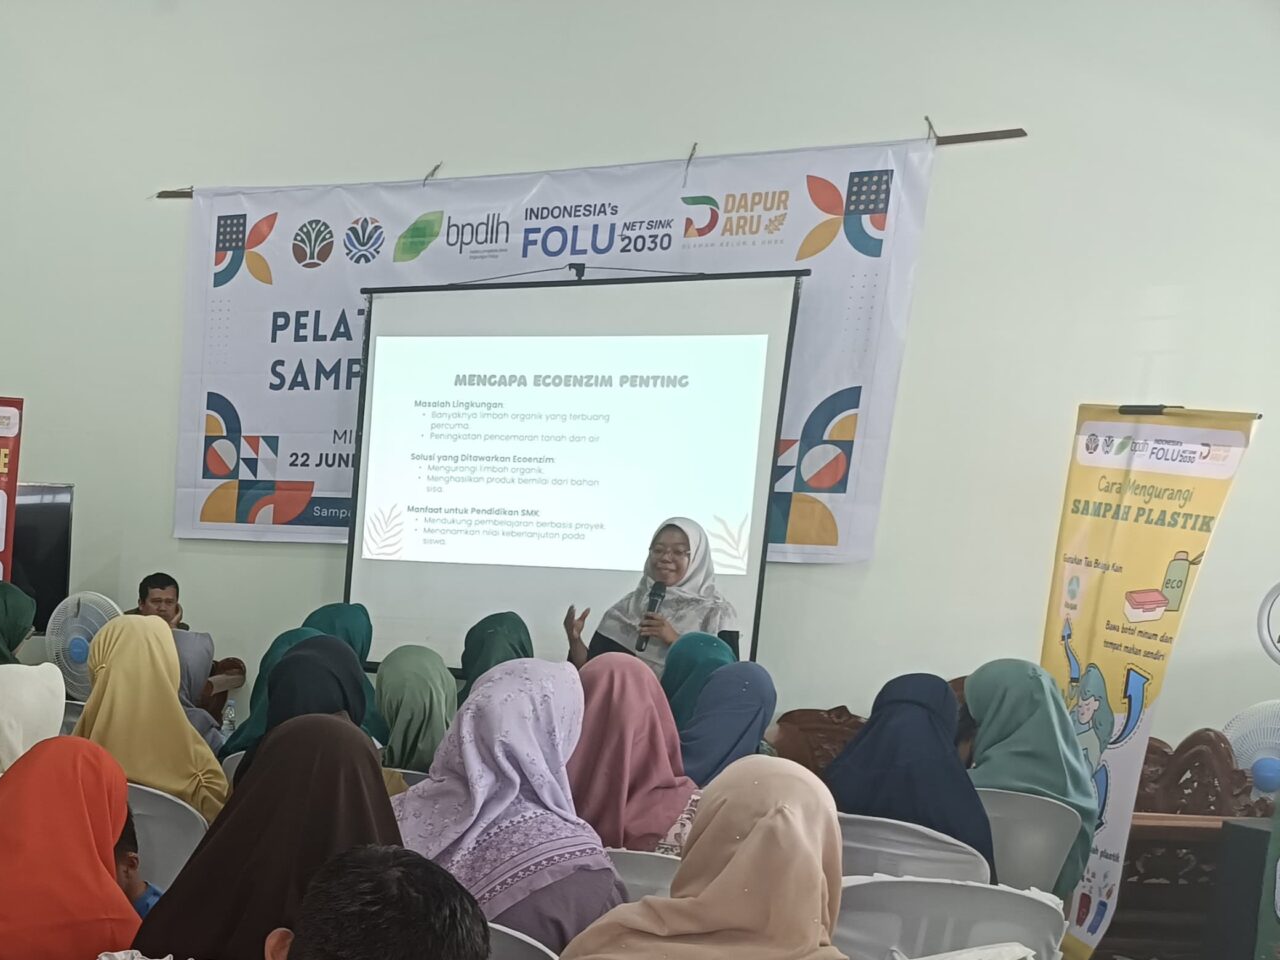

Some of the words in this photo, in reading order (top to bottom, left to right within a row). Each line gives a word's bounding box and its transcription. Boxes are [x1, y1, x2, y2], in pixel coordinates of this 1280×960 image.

[723, 190, 790, 214] DAPUR
[524, 203, 619, 220] INDONESIA's
[623, 221, 646, 232] NET
[647, 219, 675, 230] SINK
[720, 214, 762, 236] ARU
[446, 213, 510, 254] bpdlh
[521, 222, 617, 258] FOLU
[620, 233, 673, 253] 2030
[454, 374, 528, 387] MENGAPA
[532, 374, 613, 387] ECOENZIM
[619, 375, 690, 388] PENTING
[414, 400, 451, 408] Masalah
[545, 414, 567, 423] yang
[569, 412, 610, 423] terbuang
[289, 452, 310, 467] 22
[410, 453, 436, 462] Solusi
[437, 455, 459, 464] yang
[460, 453, 511, 463] Ditawarkan
[1149, 446, 1179, 462] FOLU
[427, 464, 477, 475] Mengurangi
[486, 475, 516, 485] produk
[1098, 475, 1121, 494] Cara
[1126, 477, 1196, 509] Mengurangi
[407, 505, 442, 513] Manfaat
[444, 506, 469, 515] untuk
[470, 507, 519, 516] Pendidikan
[1071, 498, 1132, 521] SAMPAH
[1134, 505, 1216, 533] PLASTIK
[1165, 578, 1183, 589] eco
[1105, 620, 1120, 633] Bawa
[1121, 623, 1137, 636] botol
